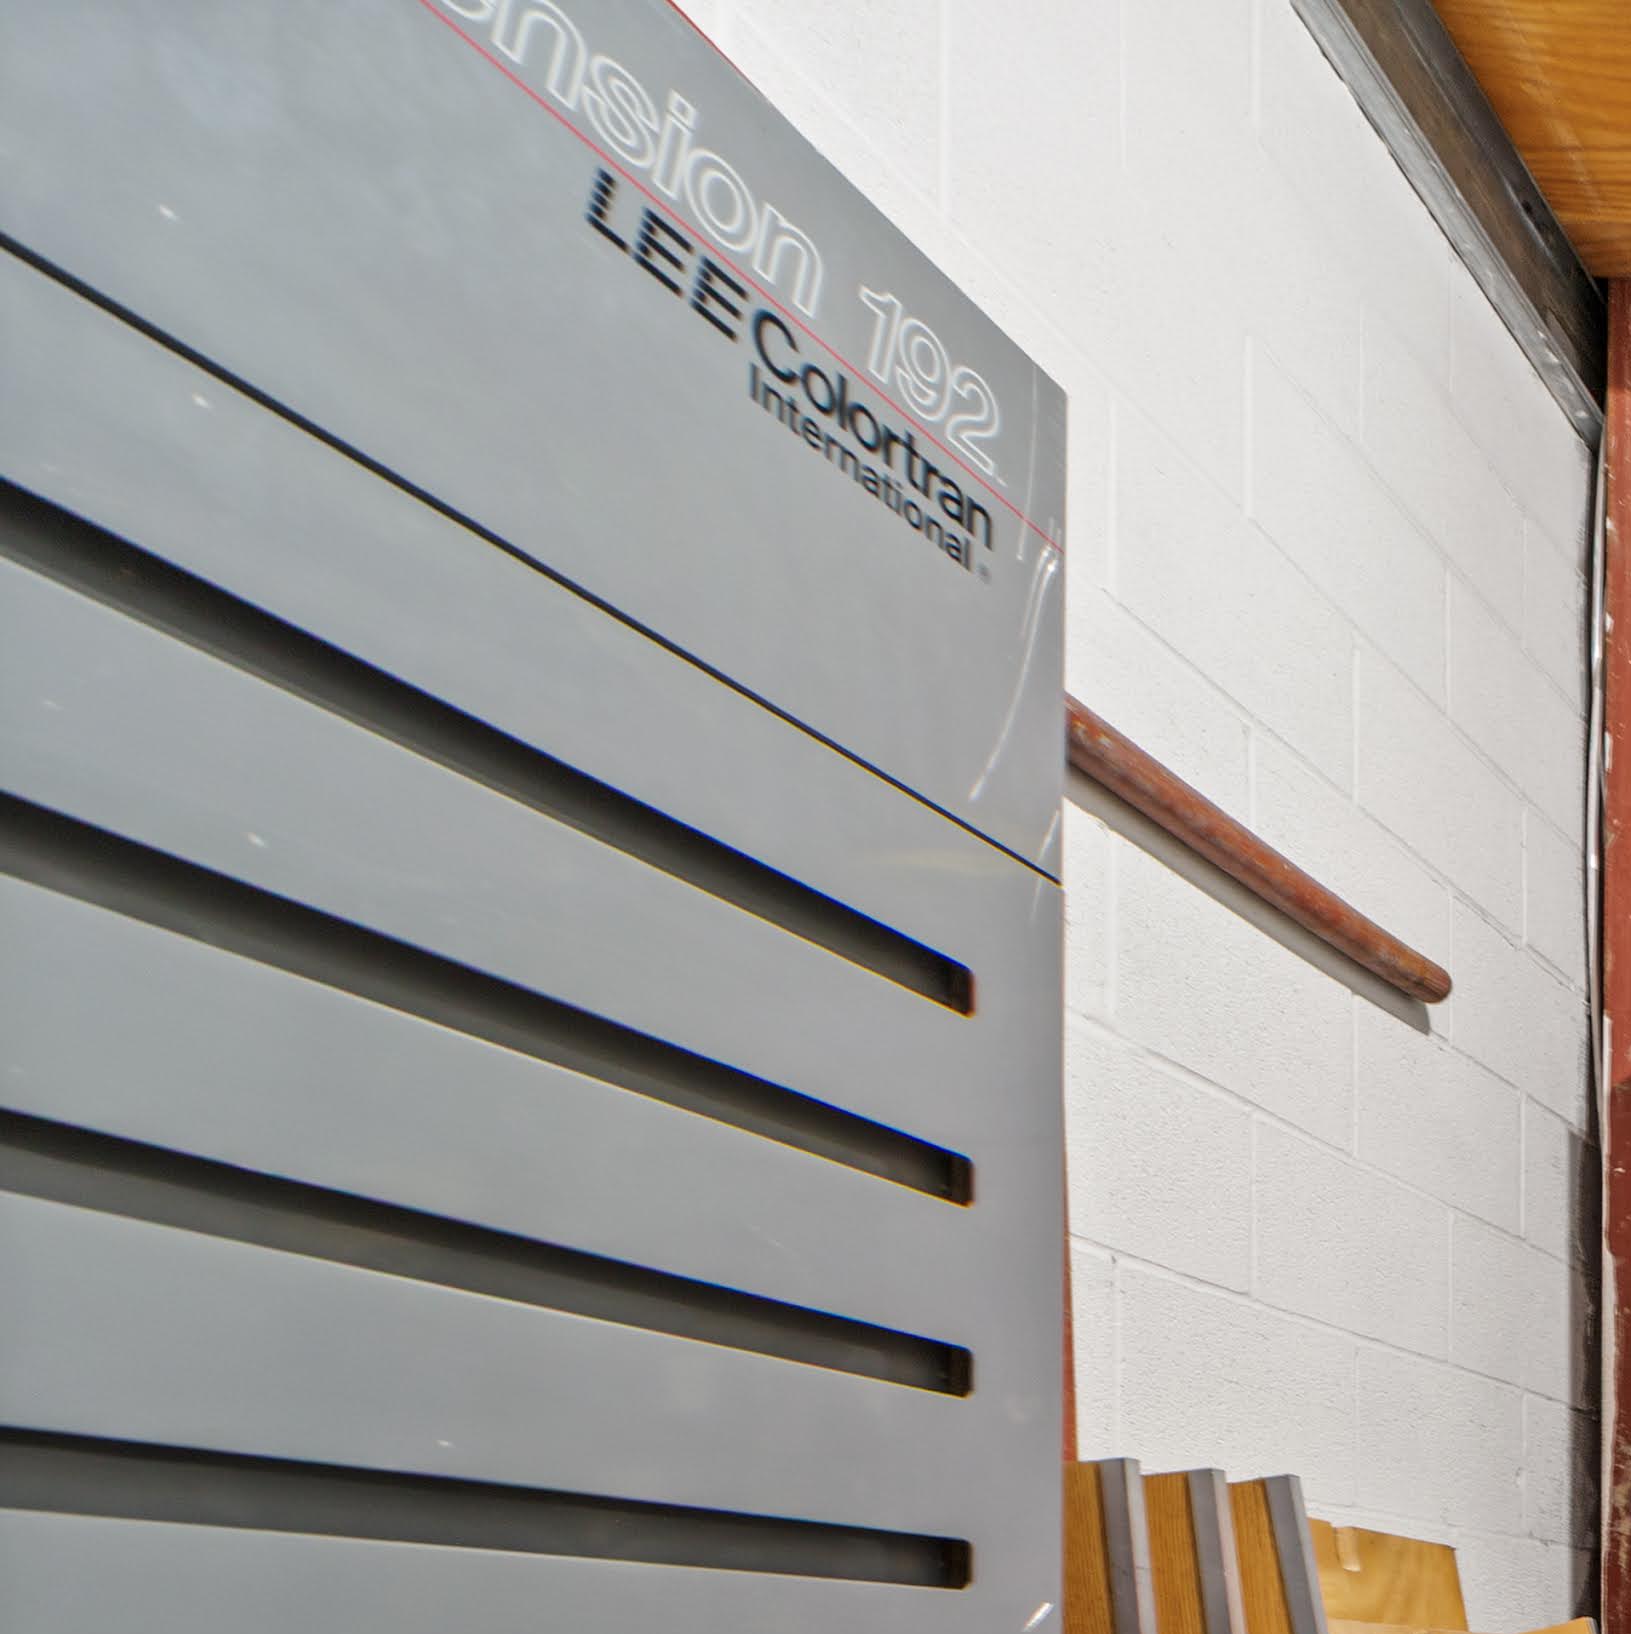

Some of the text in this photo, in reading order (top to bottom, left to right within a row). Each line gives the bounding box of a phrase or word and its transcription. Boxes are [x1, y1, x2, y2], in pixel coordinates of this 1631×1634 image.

[582, 165, 995, 552] LEE Colortran
[858, 283, 1000, 478] 192
[749, 361, 973, 573] International
